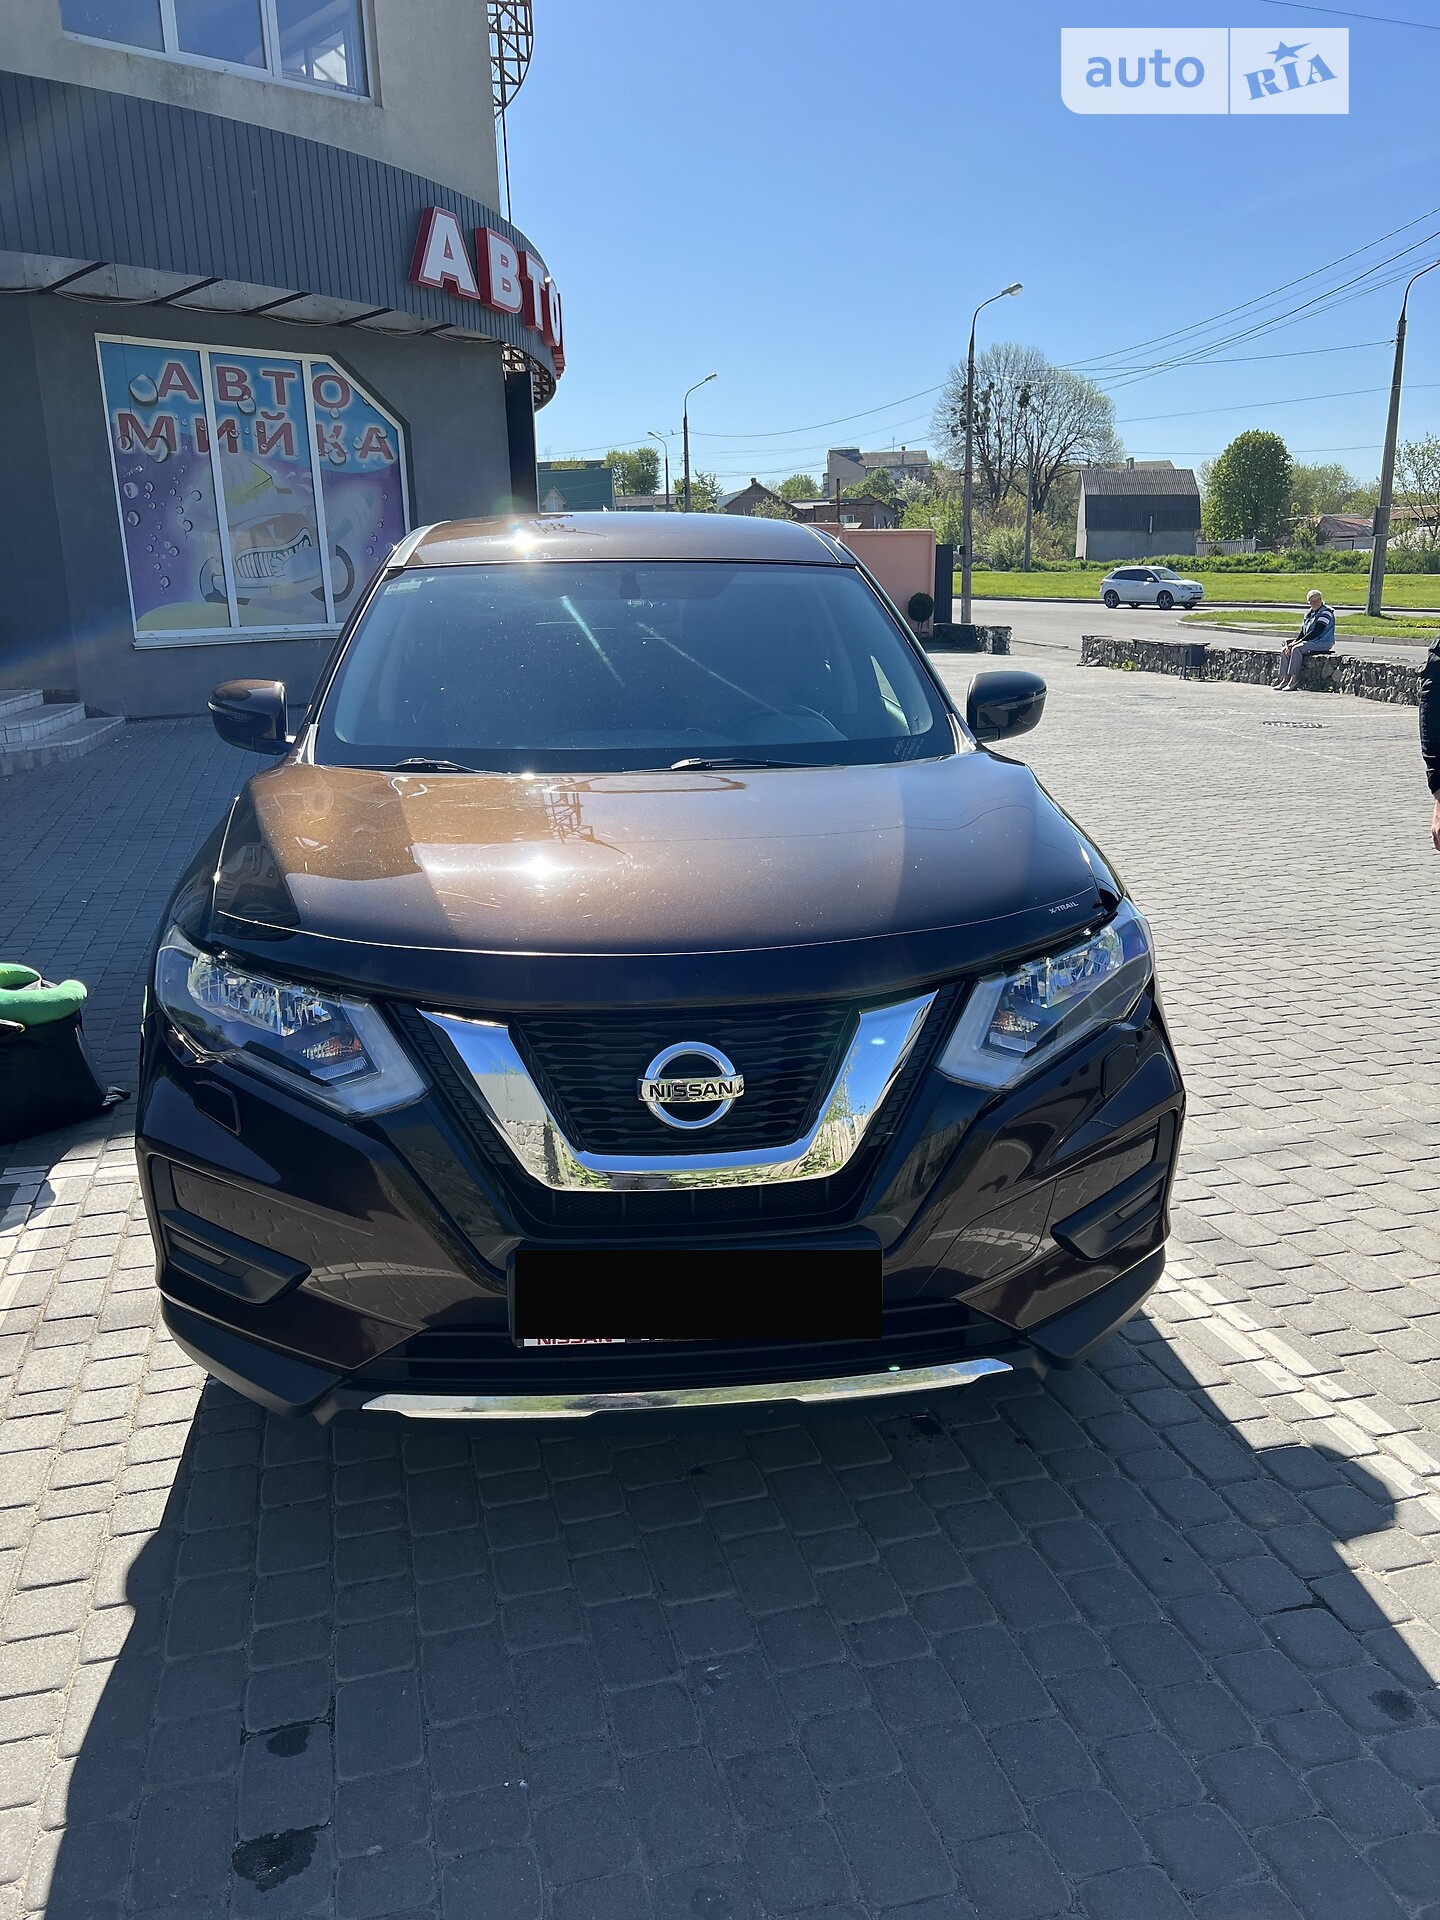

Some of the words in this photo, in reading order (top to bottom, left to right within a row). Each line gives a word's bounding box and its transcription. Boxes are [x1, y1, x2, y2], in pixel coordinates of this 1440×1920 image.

[409, 206, 561, 347] АВТО
[157, 362, 350, 409] АВТО
[117, 411, 394, 460] МИЙКА
[1048, 901, 1080, 914] X-TRAIL
[649, 1081, 734, 1098] NISSAN
